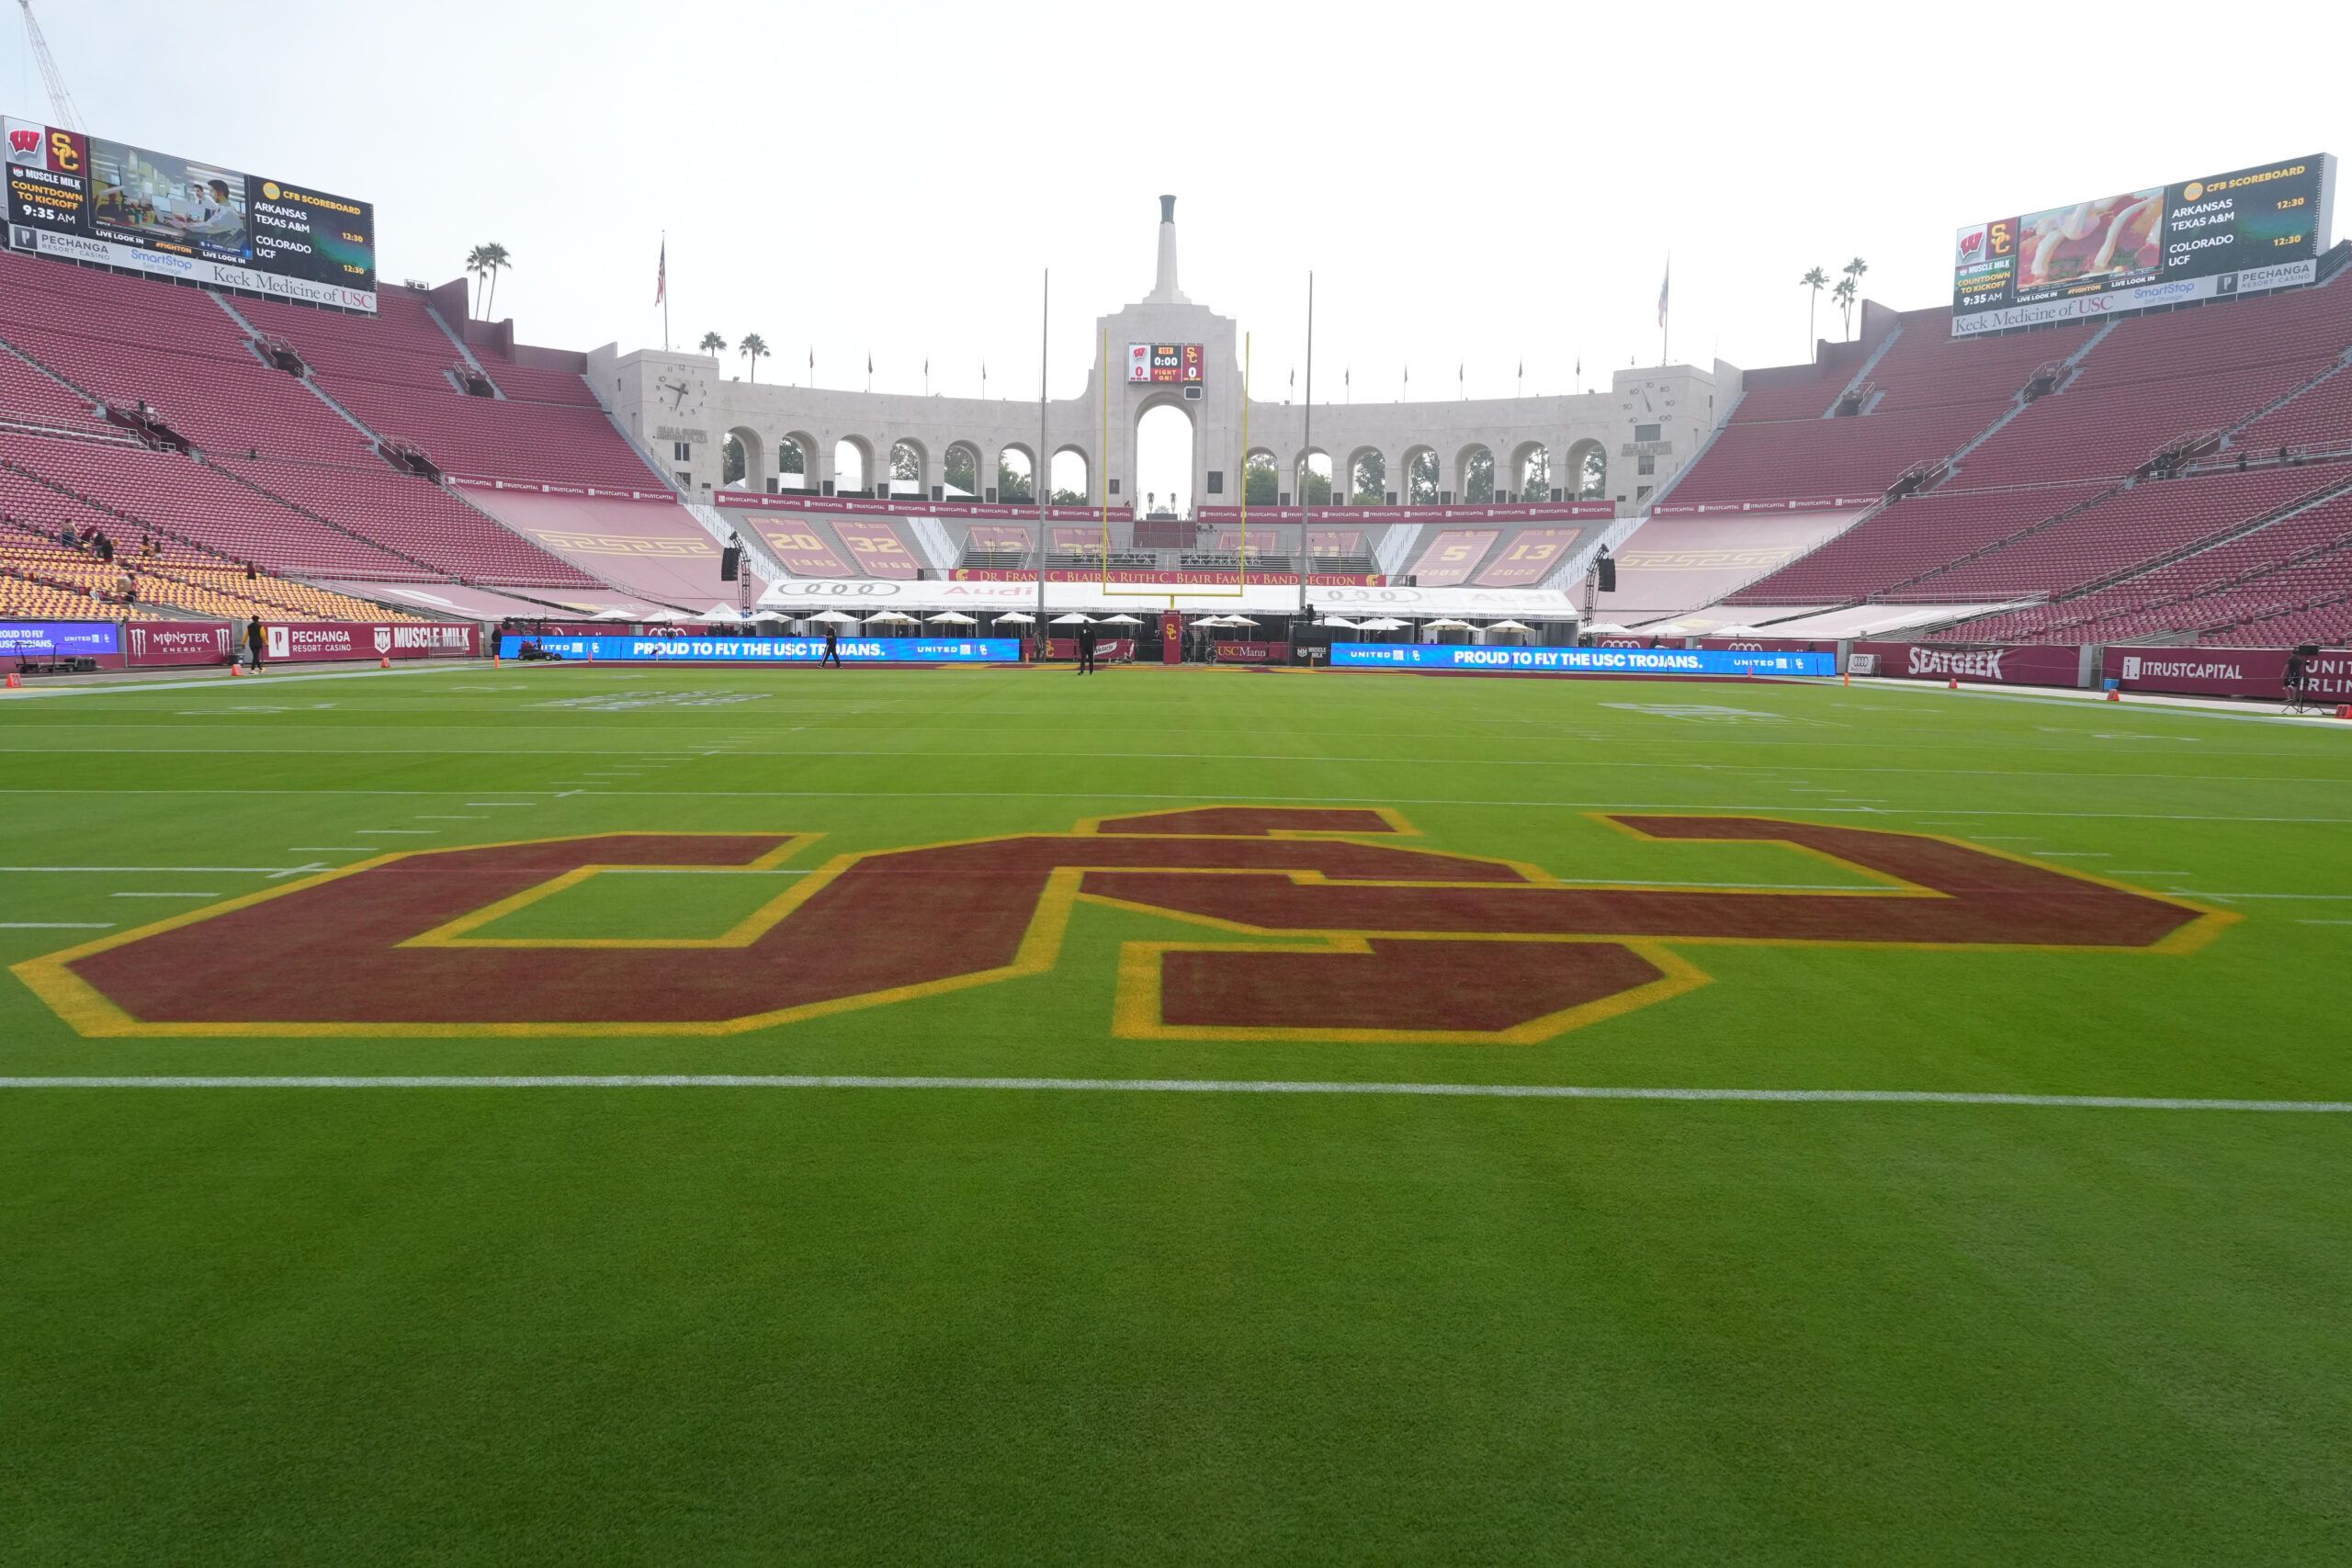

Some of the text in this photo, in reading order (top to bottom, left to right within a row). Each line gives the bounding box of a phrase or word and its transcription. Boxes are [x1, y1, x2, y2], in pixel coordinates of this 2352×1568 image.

[26, 169, 81, 188] MUSCLE MILK
[2207, 166, 2305, 193] CFB SCOREBOARD
[12, 180, 83, 202] COUNTDOWN
[17, 191, 78, 209] TO KICKOFF
[283, 191, 360, 215] CFB SCOREBOARD
[23, 205, 75, 224] 9:35 AM
[254, 202, 307, 220] ARKANSAS
[2172, 197, 2304, 219] ARKANSAS 12:30
[254, 214, 310, 233] TEXAS A&M
[2172, 211, 2234, 231] TEXAS A&M
[96, 230, 112, 239] LIVE
[114, 233, 134, 243] LOOK
[342, 232, 363, 243] 12:30
[2170, 234, 2301, 254] COLORADO 12:30
[42, 235, 108, 254] PECHANGA
[42, 243, 109, 260] RESORT CASINO
[155, 243, 191, 254] #FIGHTON
[255, 235, 311, 254] COLORADO
[131, 250, 192, 270] SmartStop
[218, 254, 237, 263] LOOK
[256, 248, 276, 258] UCF
[2169, 255, 2190, 266] UCF
[343, 265, 364, 275] 12:30
[1969, 259, 2010, 274] MUSCLE MILK
[2243, 265, 2310, 282] PECHANGA
[1957, 272, 2010, 287] COUNTDOWN
[1973, 281, 2006, 292] KICKOFF
[2242, 274, 2310, 288] RESORT CASINO
[214, 266, 373, 309] Keck Medicine of USC
[2068, 285, 2101, 295] #FIGHTON
[2134, 282, 2195, 299] SmartStop
[1963, 292, 2002, 306] 9:35 AM
[2031, 293, 2048, 301] LOOK
[1955, 296, 2114, 333] Keck Medicine of USC
[1154, 357, 1178, 366] 0:00
[1136, 367, 1143, 377] 0
[1189, 367, 1196, 378] 0
[766, 534, 823, 549] 20
[847, 536, 904, 553] 32
[1441, 546, 1472, 560] 5
[1508, 545, 1556, 559] 13
[979, 571, 1001, 581] DR.
[1005, 571, 1046, 581] FRAN
[1050, 572, 1062, 581] C.
[1068, 572, 1102, 582] BLAIR
[1106, 572, 1115, 582] &
[1120, 572, 1155, 583] RUTH
[1159, 573, 1171, 583] C.
[1176, 574, 1211, 583] BLAIR
[1216, 573, 1259, 584] FAMLY
[1263, 574, 1298, 584] BAND
[943, 586, 1032, 596] Audi
[153, 631, 210, 644] MONSTER
[292, 630, 350, 643] PECHANGA
[394, 627, 469, 648] MUSCLE MILK
[1167, 624, 1176, 639] SC
[293, 644, 322, 652] RESORT
[634, 642, 886, 656] PROUD TO FLY THE USC TRJANS.
[1217, 647, 1266, 656] USC Mann
[1454, 650, 1703, 669] PROUD TO FLY THE USC TROJANS.
[1908, 647, 2004, 680] SEATGEEK
[2143, 661, 2242, 680] ITRUSTCAPITAL
